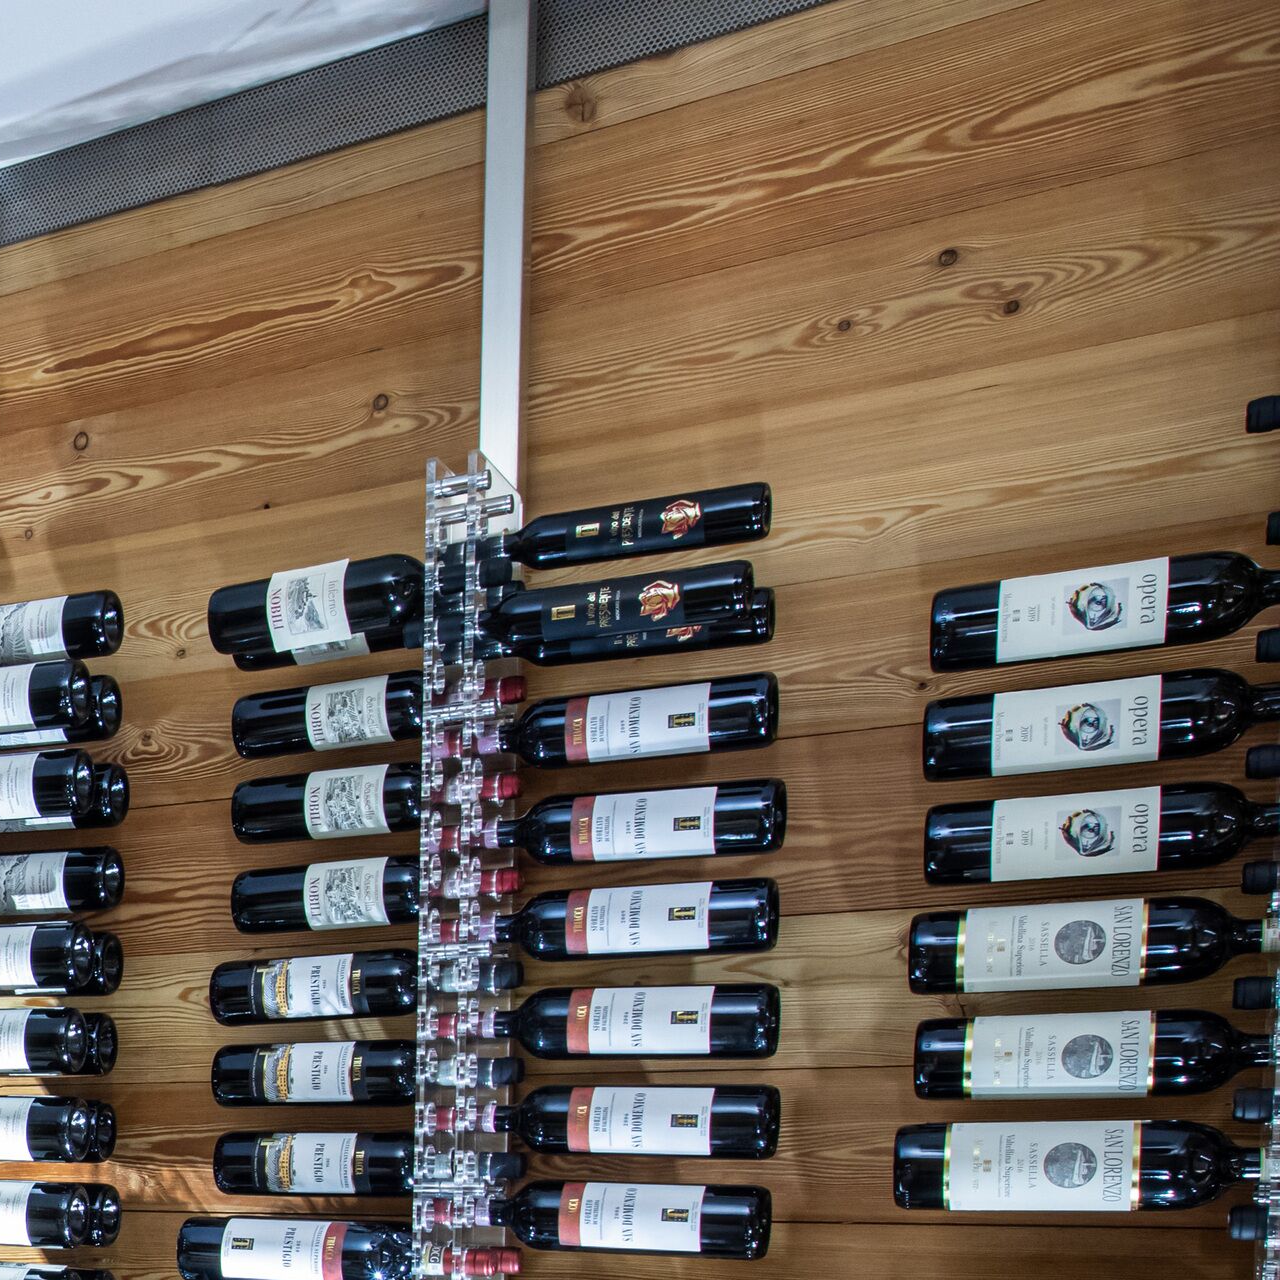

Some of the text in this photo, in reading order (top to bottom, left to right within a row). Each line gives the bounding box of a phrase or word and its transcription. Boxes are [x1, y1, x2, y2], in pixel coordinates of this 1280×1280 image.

[270, 587, 282, 631] NOBILI
[1137, 573, 1158, 626] opera
[310, 703, 325, 743] NOBILI
[590, 716, 599, 745] SFORZATO
[630, 697, 643, 754] SAN DOMENICO
[1130, 695, 1149, 746] opera
[578, 817, 589, 846] TRIACCA
[596, 816, 604, 843] SFORZATO
[635, 798, 648, 855] SAN DOMENICO
[1130, 803, 1149, 854] opera
[309, 877, 321, 920] NOBILI
[630, 890, 643, 946] SAN DOMENICO
[1040, 921, 1048, 966] SASSELLA
[1111, 926, 1132, 978] LORENZO
[312, 964, 322, 1007] PRESTIGIO
[631, 991, 647, 1047] SAN DOMENICO
[1119, 1043, 1139, 1092] LORENZO
[314, 1143, 326, 1184] PRESTIGIO
[1028, 1142, 1038, 1189] SASSELLA
[1102, 1153, 1123, 1203] LORENZO
[282, 1227, 297, 1268] PRESTIGIO
